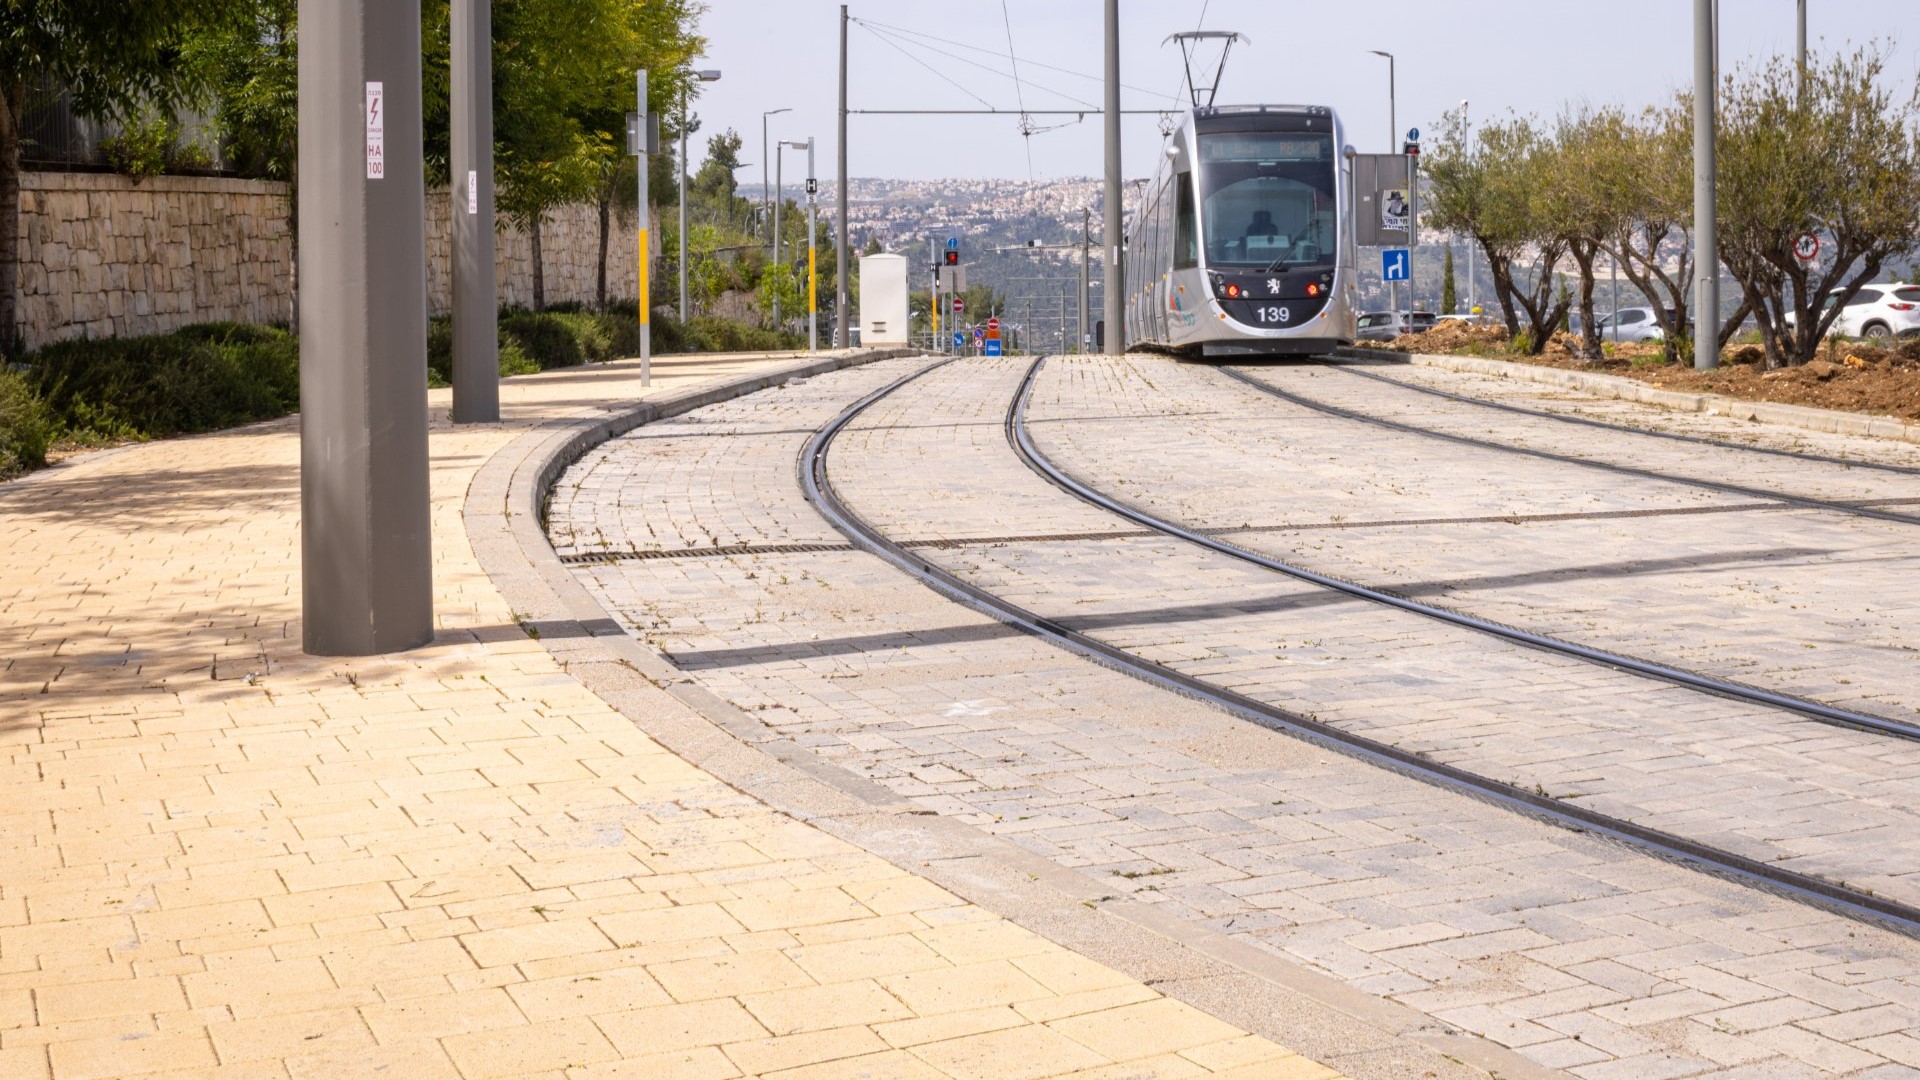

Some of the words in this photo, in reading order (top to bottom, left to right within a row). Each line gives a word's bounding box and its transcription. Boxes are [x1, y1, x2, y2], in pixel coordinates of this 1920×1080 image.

[368, 145, 381, 156] HA
[368, 162, 382, 174] 100
[807, 180, 816, 191] H
[809, 195, 815, 203] S
[1257, 307, 1290, 322] 139
